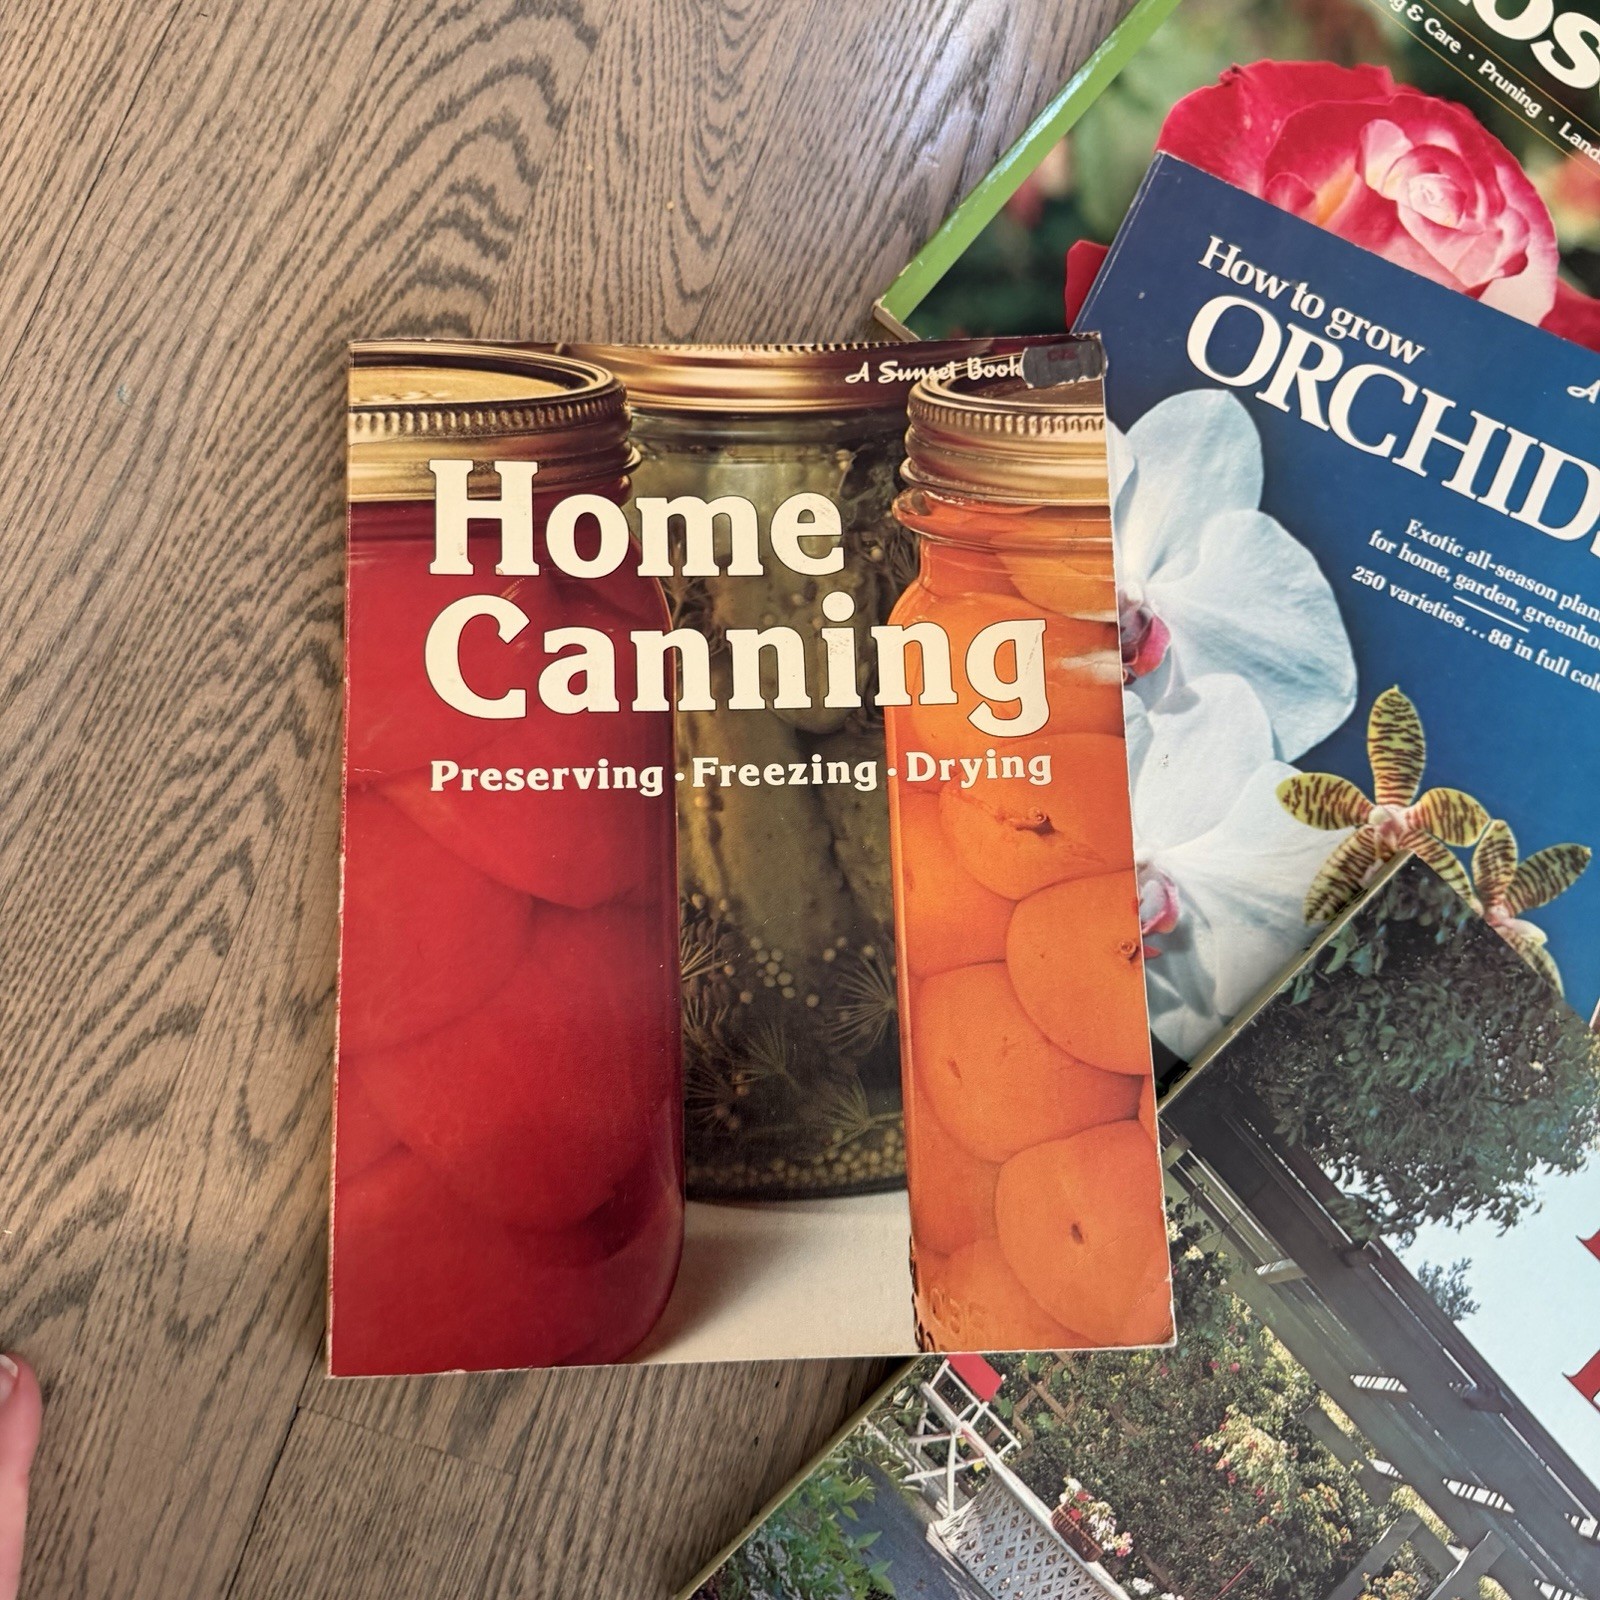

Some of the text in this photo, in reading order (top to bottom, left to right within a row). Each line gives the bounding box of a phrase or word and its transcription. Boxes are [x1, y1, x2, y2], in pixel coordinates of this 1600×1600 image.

[1406, 4, 1424, 22] &
[1424, 17, 1462, 54] Care
[1478, 59, 1543, 118] Pruning
[1198, 235, 1425, 365] How to grow
[845, 361, 870, 383] A
[877, 360, 957, 384] Sunset
[1186, 294, 1600, 558] ORCHID
[428, 459, 846, 579] Home
[1405, 518, 1600, 623] Exotic all-season plan
[1351, 565, 1386, 591] 250
[1514, 638, 1533, 661] in
[1534, 648, 1571, 678] full
[1368, 530, 1600, 651] for home, garden, greenho
[423, 591, 1052, 738] Canning
[430, 748, 1053, 797] Preserving Freezing Drying
